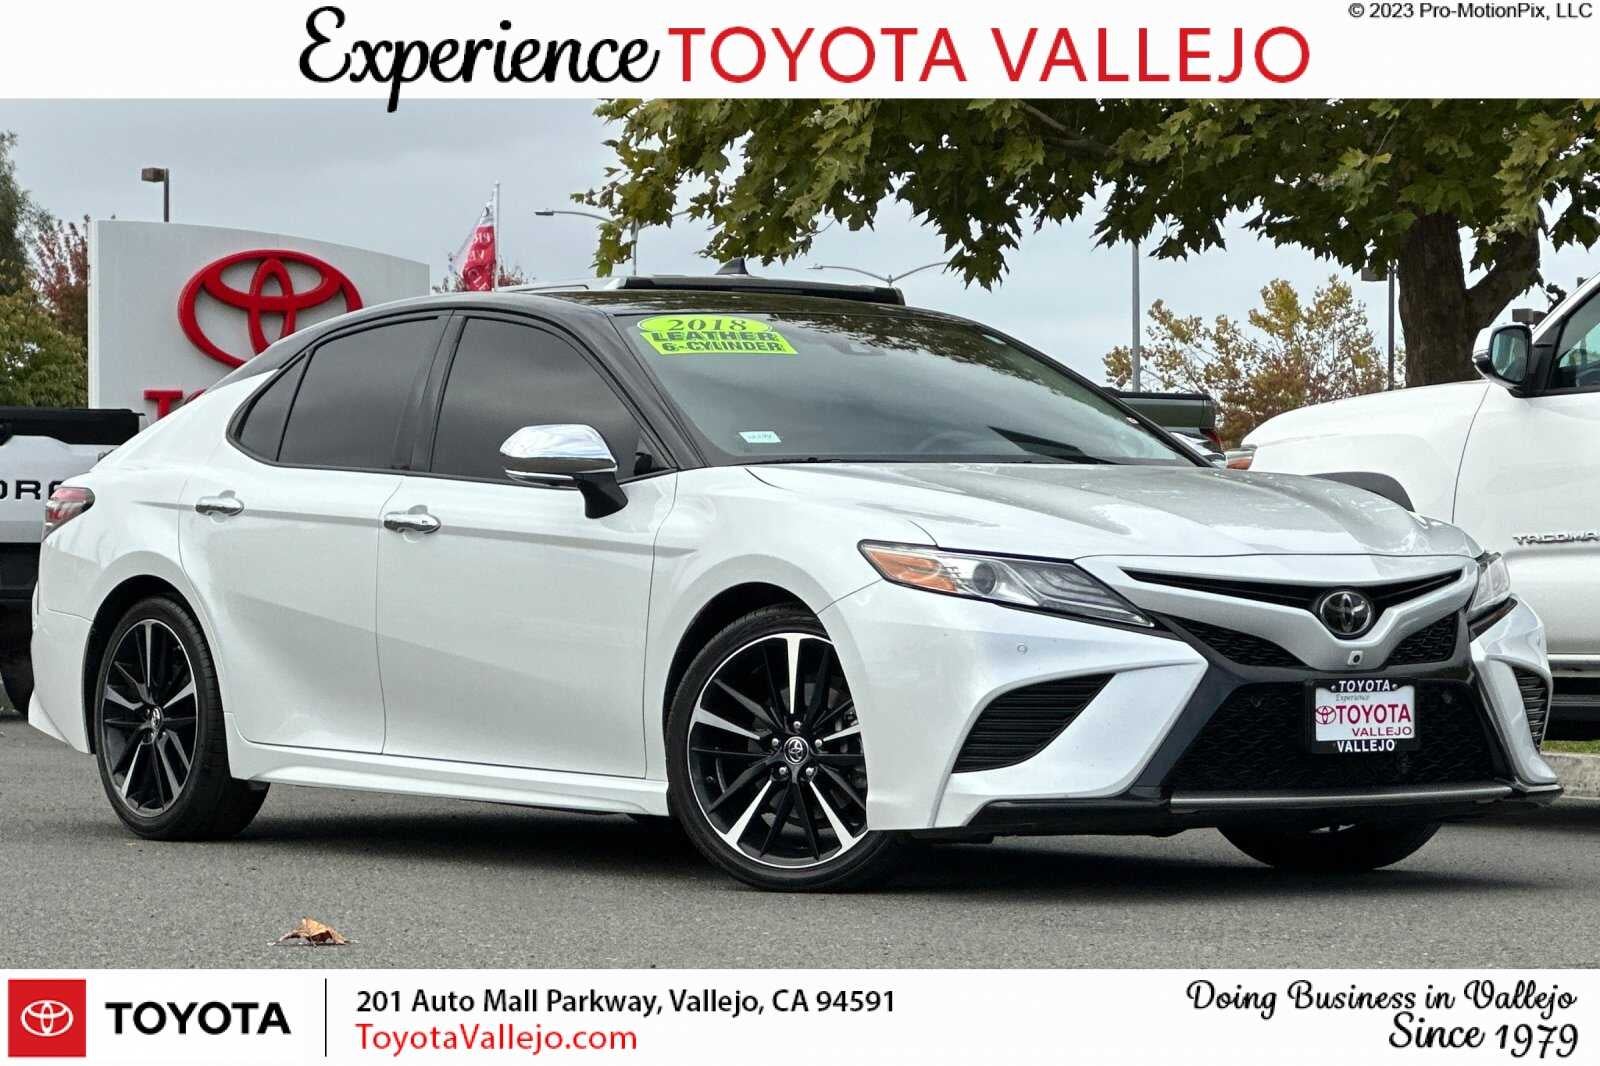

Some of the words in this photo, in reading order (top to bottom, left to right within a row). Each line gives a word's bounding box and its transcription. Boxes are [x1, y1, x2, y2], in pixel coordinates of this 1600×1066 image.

[666, 318, 747, 331] 2018
[651, 330, 777, 342] LEATHER
[661, 341, 783, 353] 6-CYLINDER
[1339, 680, 1391, 692] TOYOTA
[1335, 703, 1412, 724] TOYOTA
[1352, 726, 1413, 737] VALLEJO
[1336, 739, 1396, 753] VALLEJO
